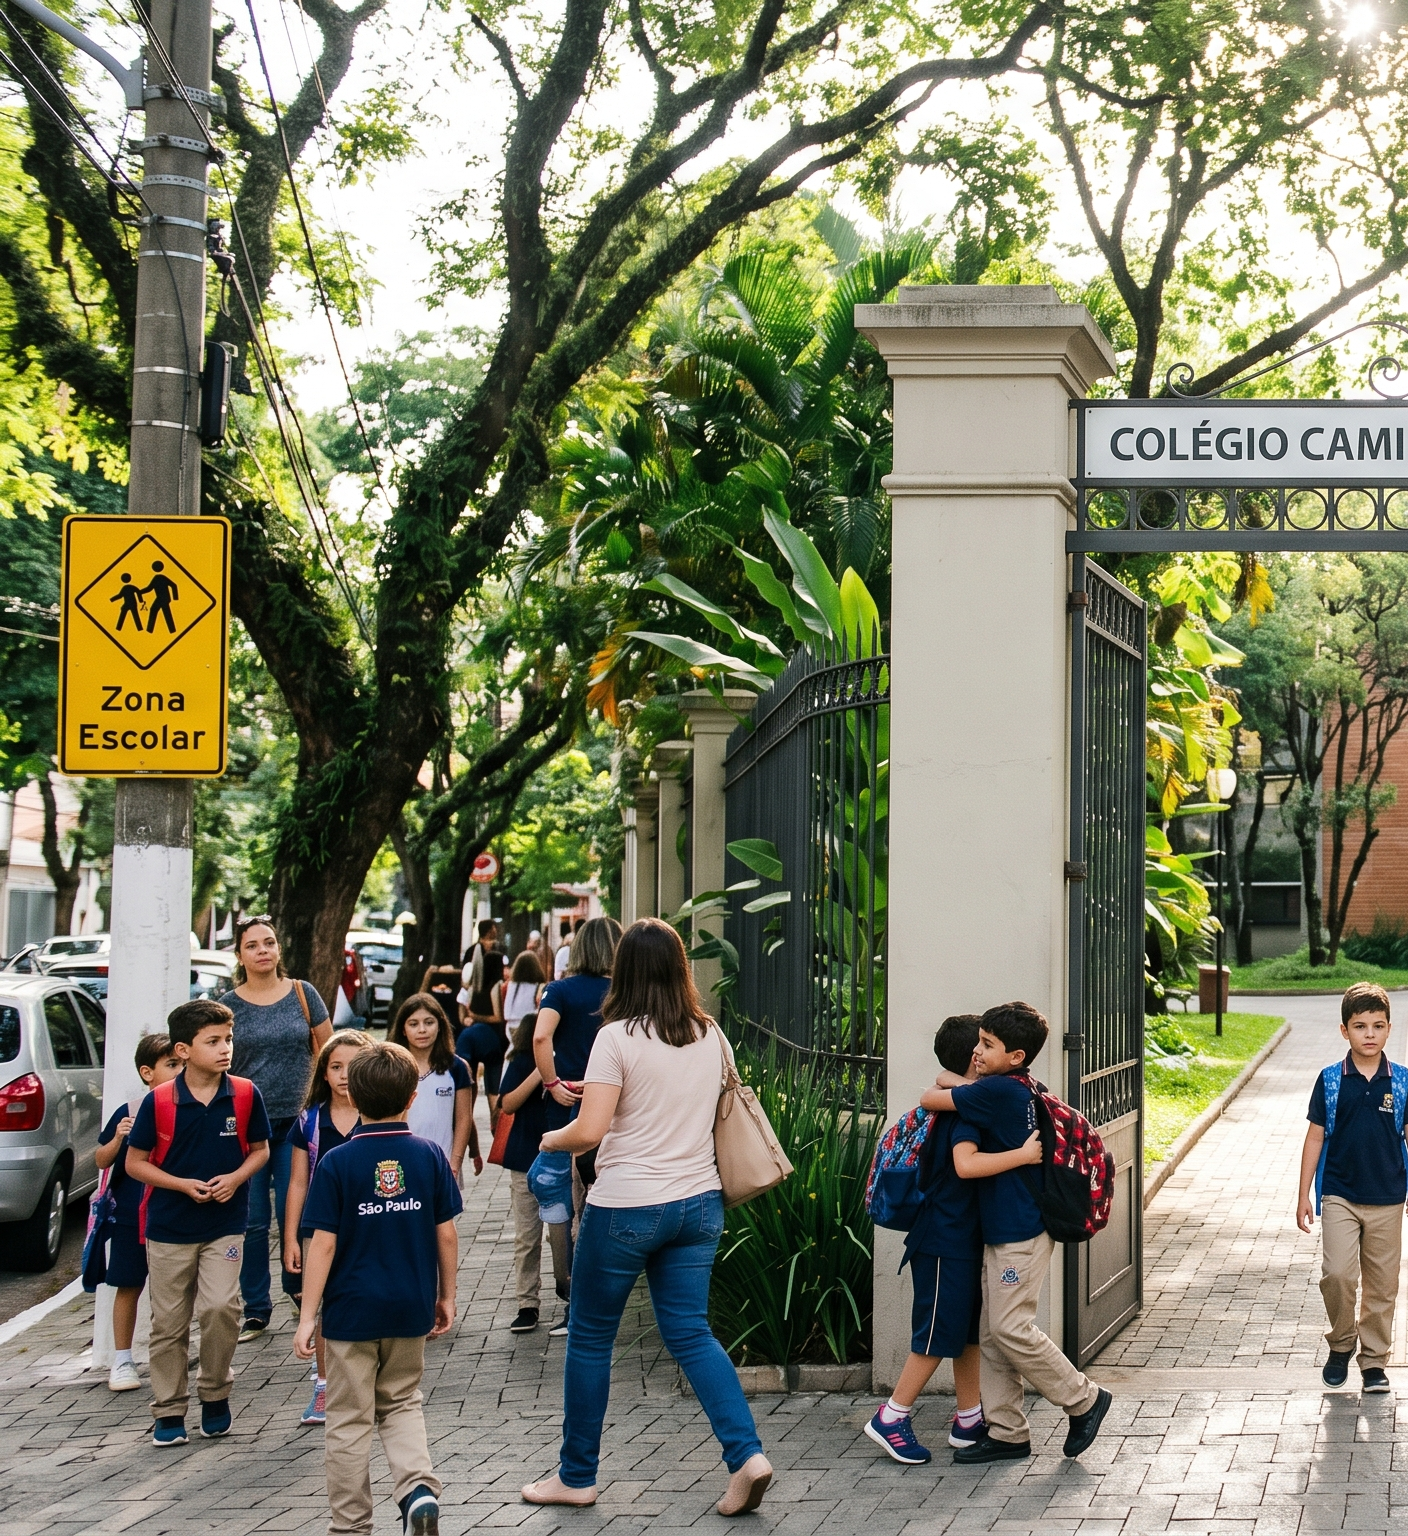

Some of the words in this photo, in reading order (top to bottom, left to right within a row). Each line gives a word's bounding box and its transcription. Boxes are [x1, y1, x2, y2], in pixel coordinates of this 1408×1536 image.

[1109, 419, 1289, 462] COLÉGIO
[101, 685, 185, 712] Zona
[79, 723, 206, 750] Escolar
[358, 1202, 383, 1215] São
[386, 1198, 422, 1212] Paulo
